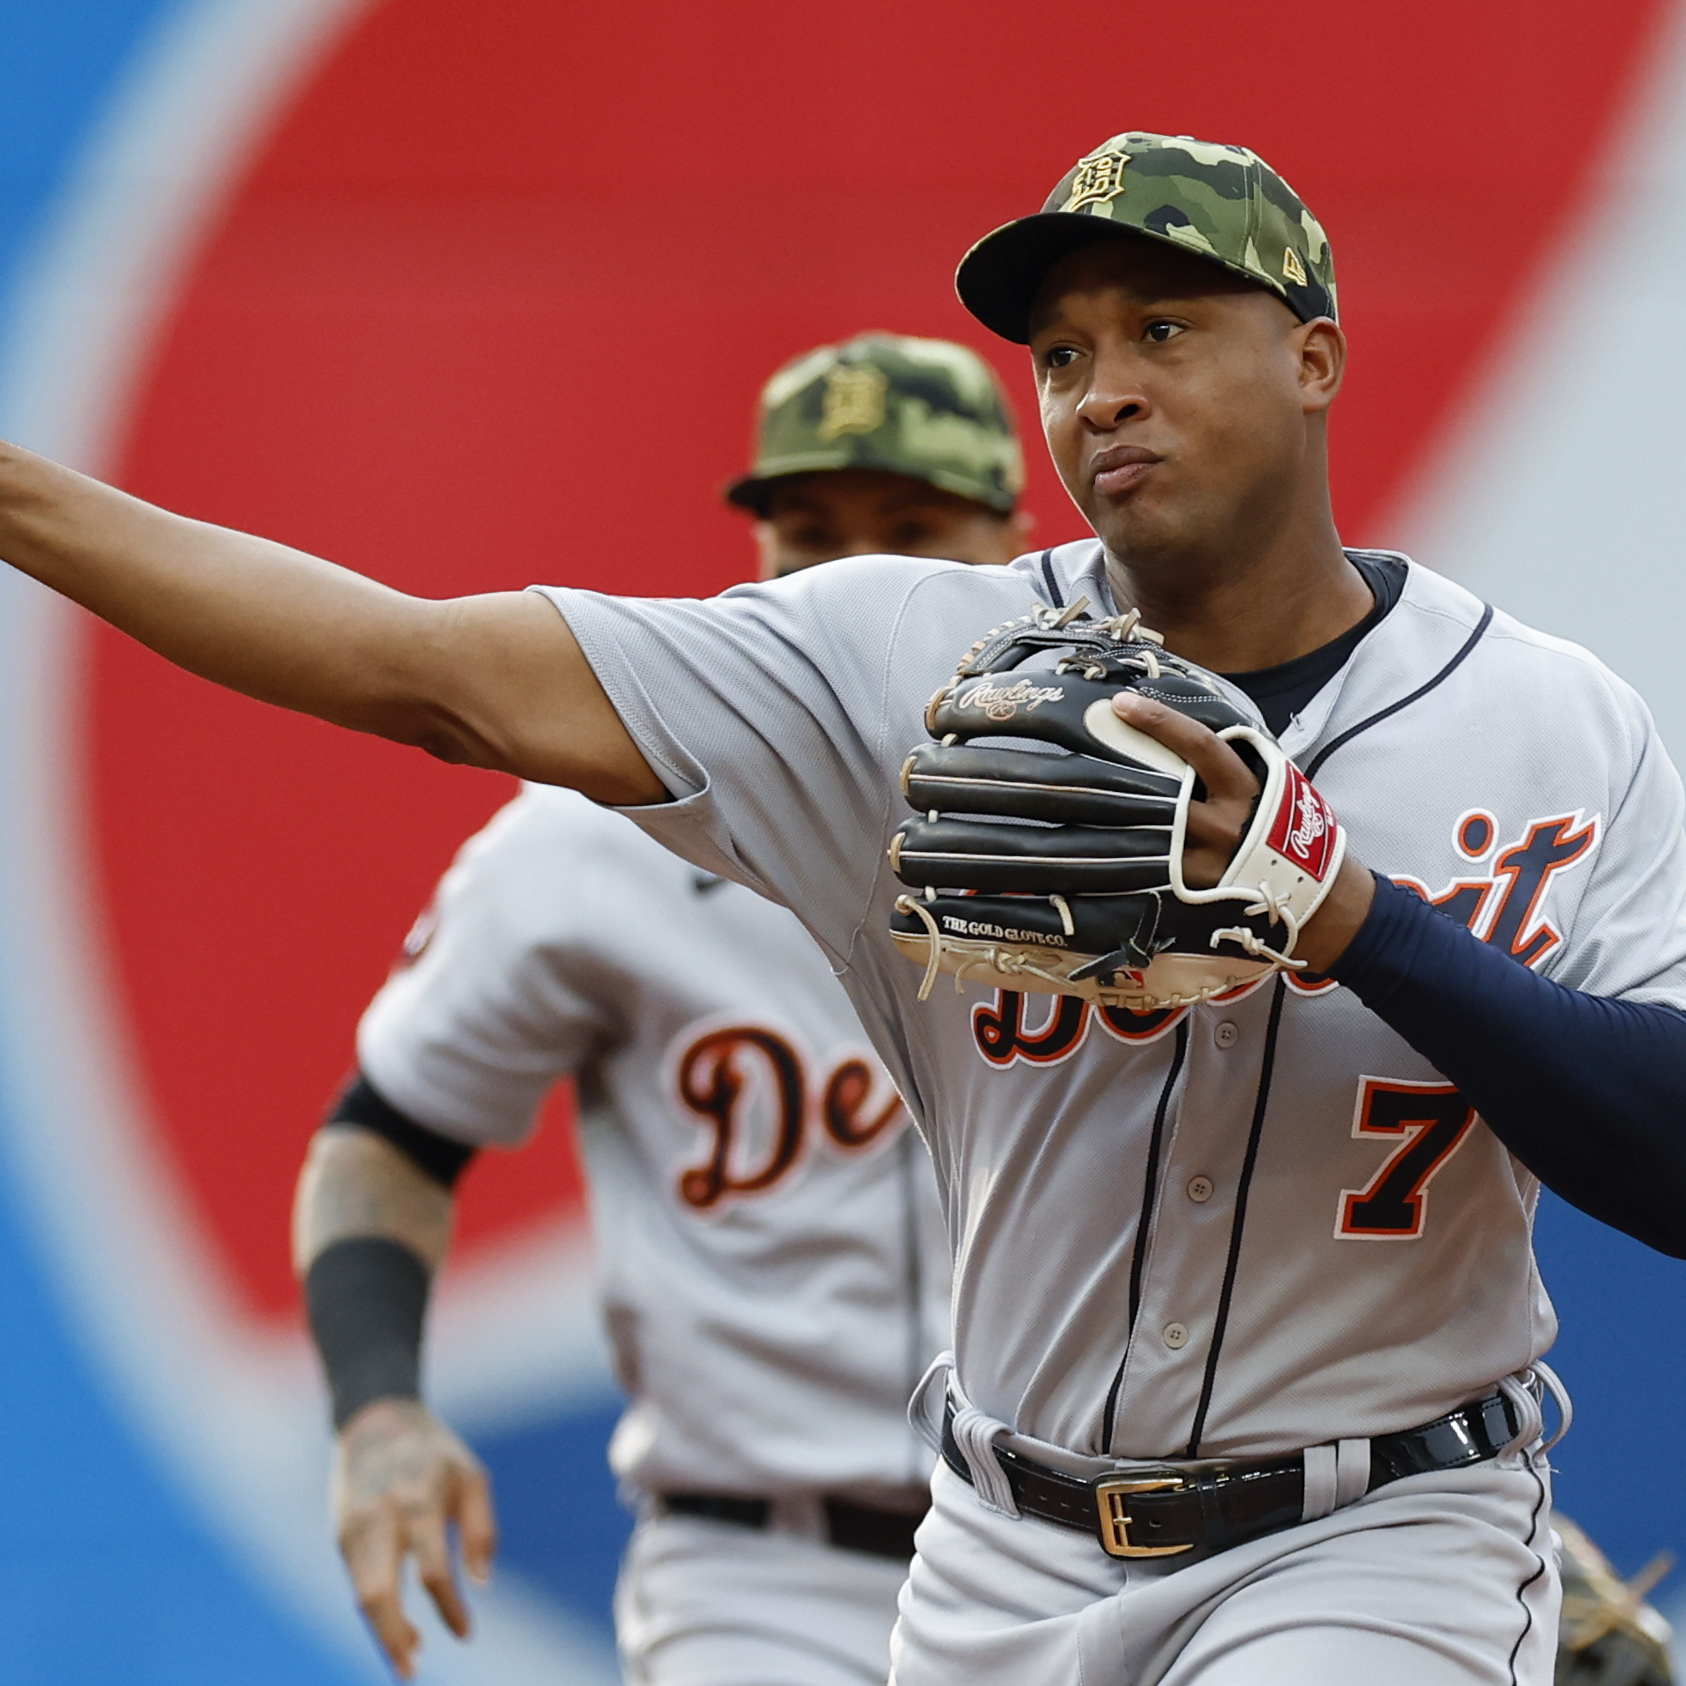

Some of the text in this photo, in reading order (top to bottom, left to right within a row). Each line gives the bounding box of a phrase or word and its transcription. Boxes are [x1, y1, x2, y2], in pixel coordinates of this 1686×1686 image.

[959, 678, 1065, 712] Rawlings
[942, 915, 1068, 947] THE GOLD GLOVE CO.
[1334, 1075, 1477, 1240] 7
